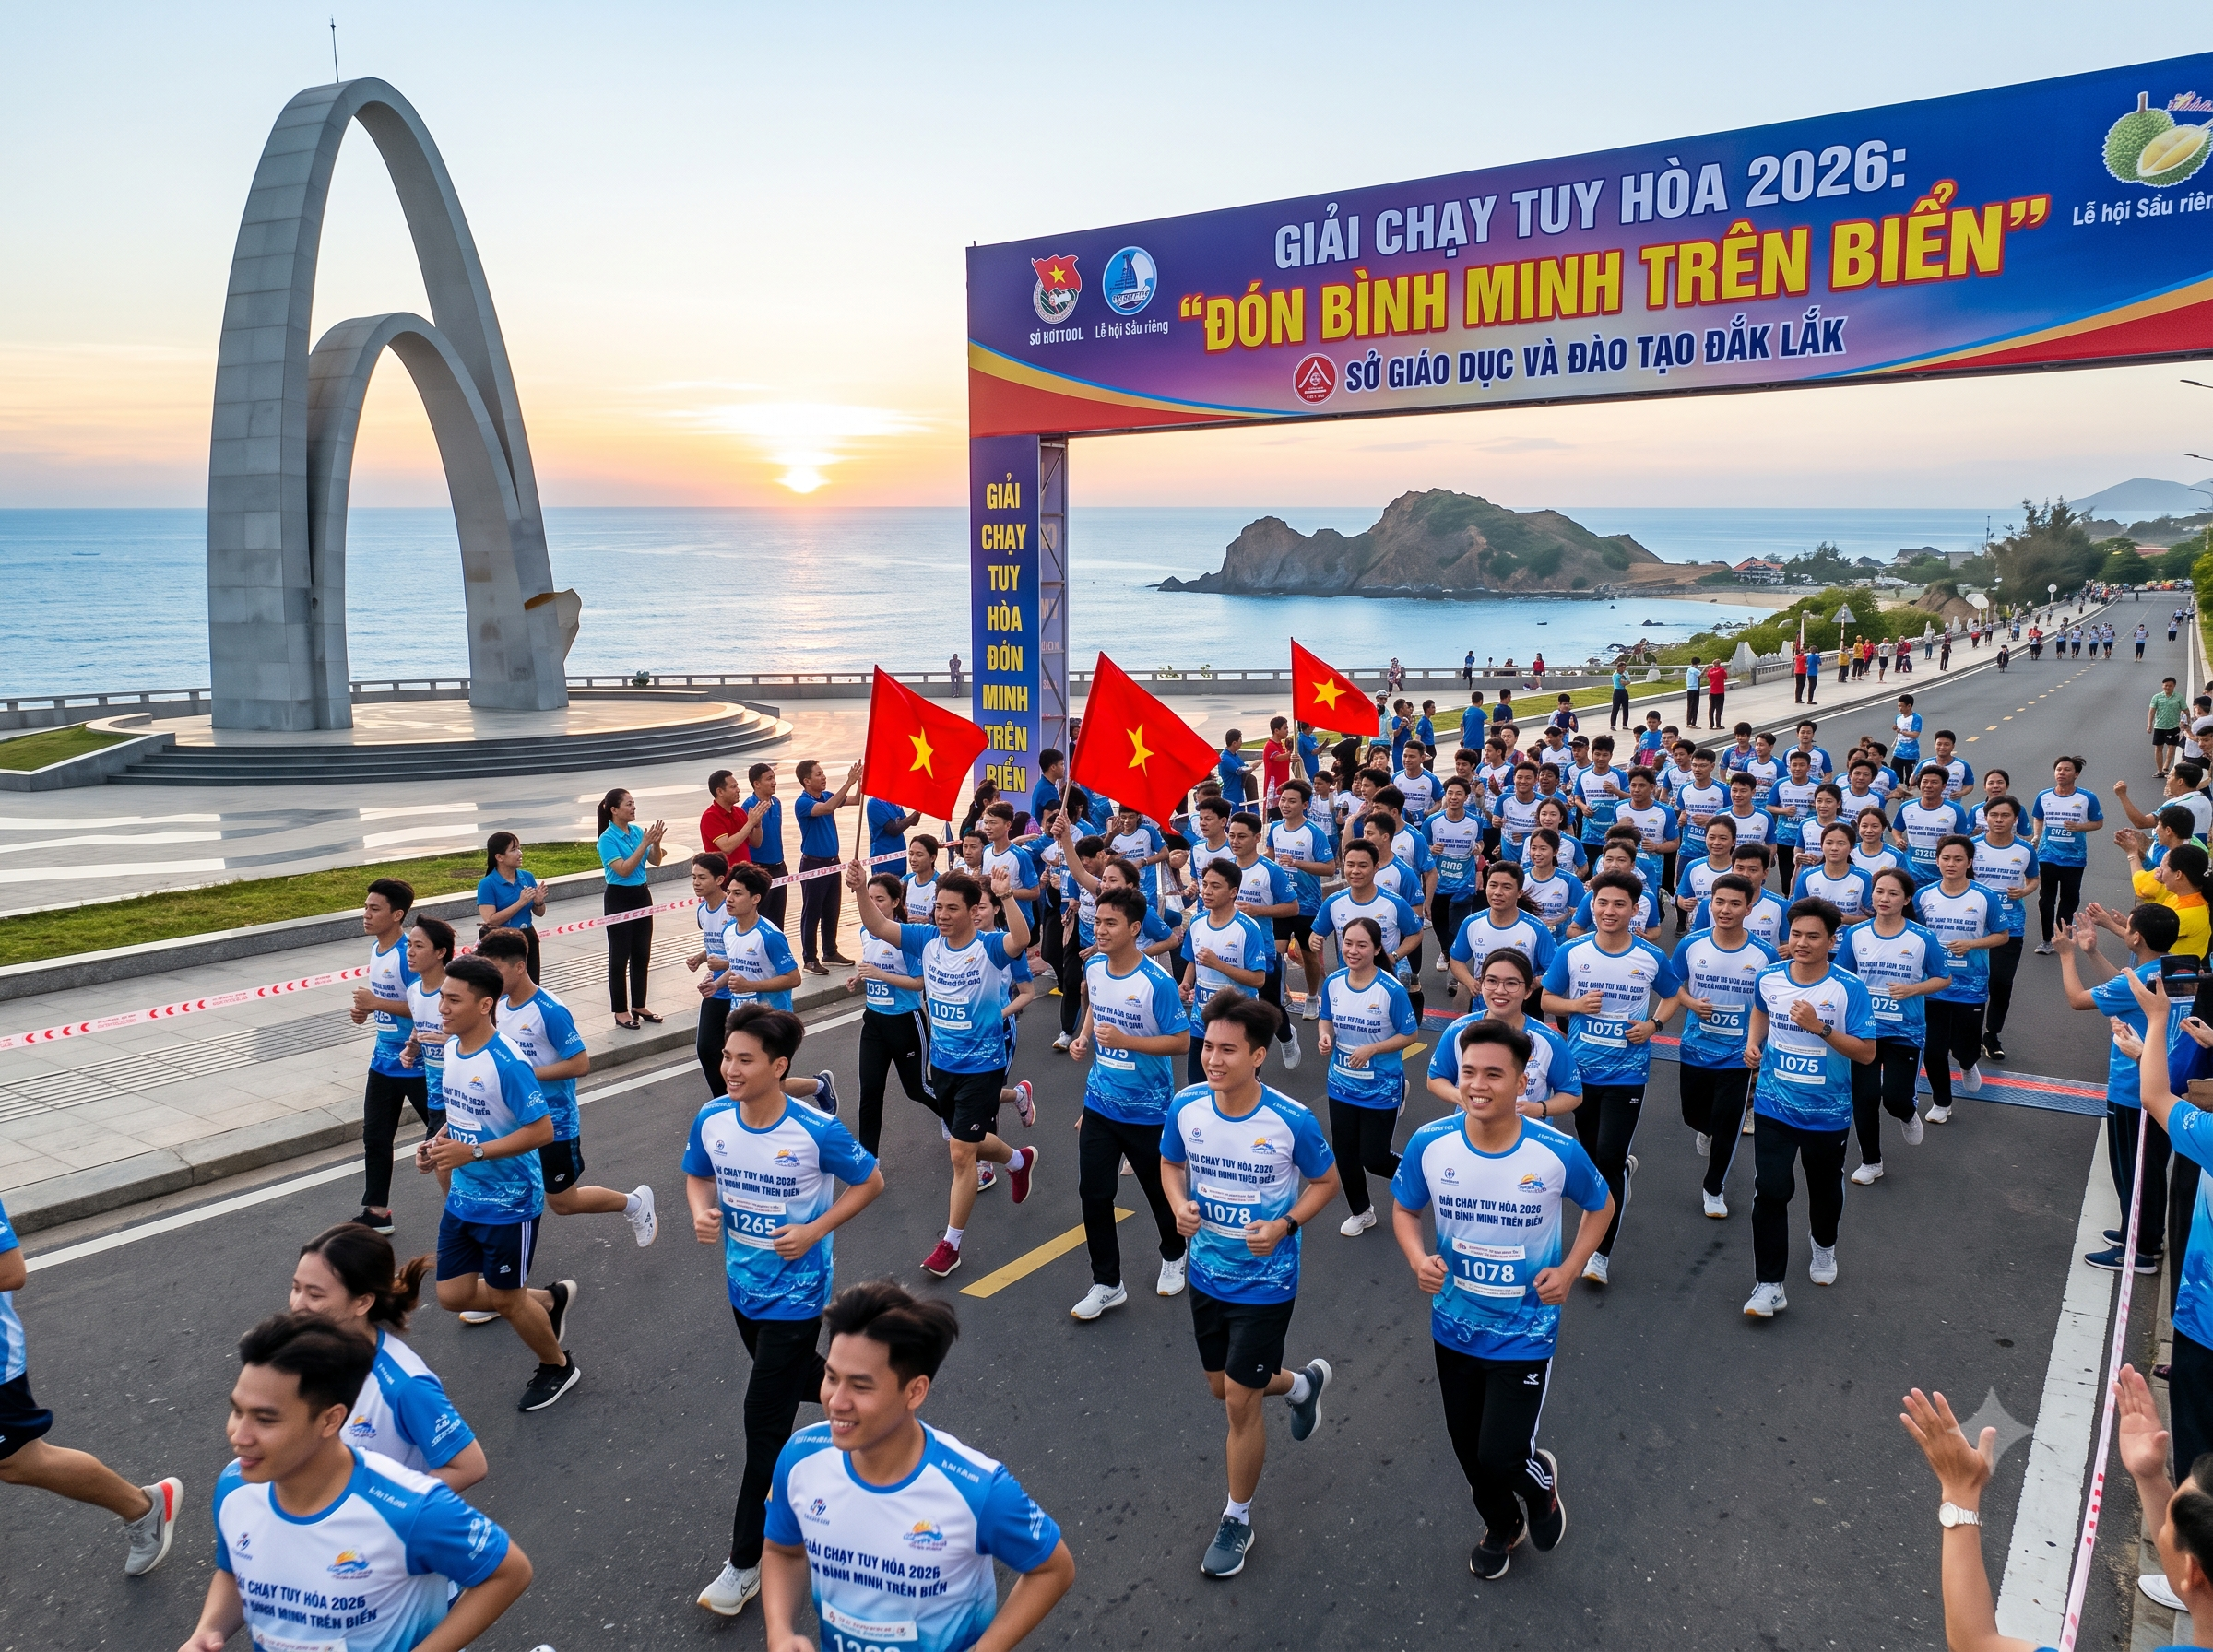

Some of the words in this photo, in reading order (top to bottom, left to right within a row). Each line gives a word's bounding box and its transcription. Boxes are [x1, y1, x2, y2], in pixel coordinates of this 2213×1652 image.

[1275, 202, 1359, 269] GIẢI
[1376, 195, 1497, 257] CHẠY
[1511, 179, 1605, 239] TUY
[1619, 156, 1731, 224] HÒA
[1746, 139, 1907, 206] 2026:
[2072, 200, 2097, 226] Lễ
[2101, 200, 2131, 226] hội
[2136, 193, 2173, 218] Sầu
[1320, 268, 1447, 341] BÌNH
[1464, 251, 1622, 328] MINH
[1641, 221, 1809, 305] TRÊN
[1108, 322, 1123, 339] hội
[1345, 350, 1381, 391] SỞ
[1390, 349, 1450, 388] GIÁO
[1459, 348, 1514, 388] DỤC
[1523, 338, 1559, 377] VÀ
[1568, 328, 1627, 374] ĐÀO
[1637, 331, 1696, 374] TẠO
[1705, 311, 1769, 362] ĐẮK
[1781, 306, 1845, 357] LẮK
[986, 472, 1021, 510] GIẢI
[981, 524, 1027, 556] CHẠY
[988, 565, 1021, 591] TUY
[988, 599, 1023, 631] HÒA
[982, 684, 1028, 712] MINH
[934, 1003, 966, 1020] 1075
[1707, 1013, 1740, 1027] 076
[1586, 1020, 1624, 1037] 1076
[1779, 1054, 1819, 1073] 1075
[1222, 1158, 1237, 1169] TUY
[744, 1170, 758, 1181] TUY
[1204, 1201, 1251, 1225] 1078
[1480, 1199, 1497, 1210] TUY
[1520, 1204, 1542, 1214] 2026
[731, 1211, 776, 1234] 1265
[1476, 1213, 1499, 1225] MINH
[1462, 1259, 1515, 1283] 1078
[858, 1552, 879, 1570] TUY
[280, 1586, 302, 1605] TUY
